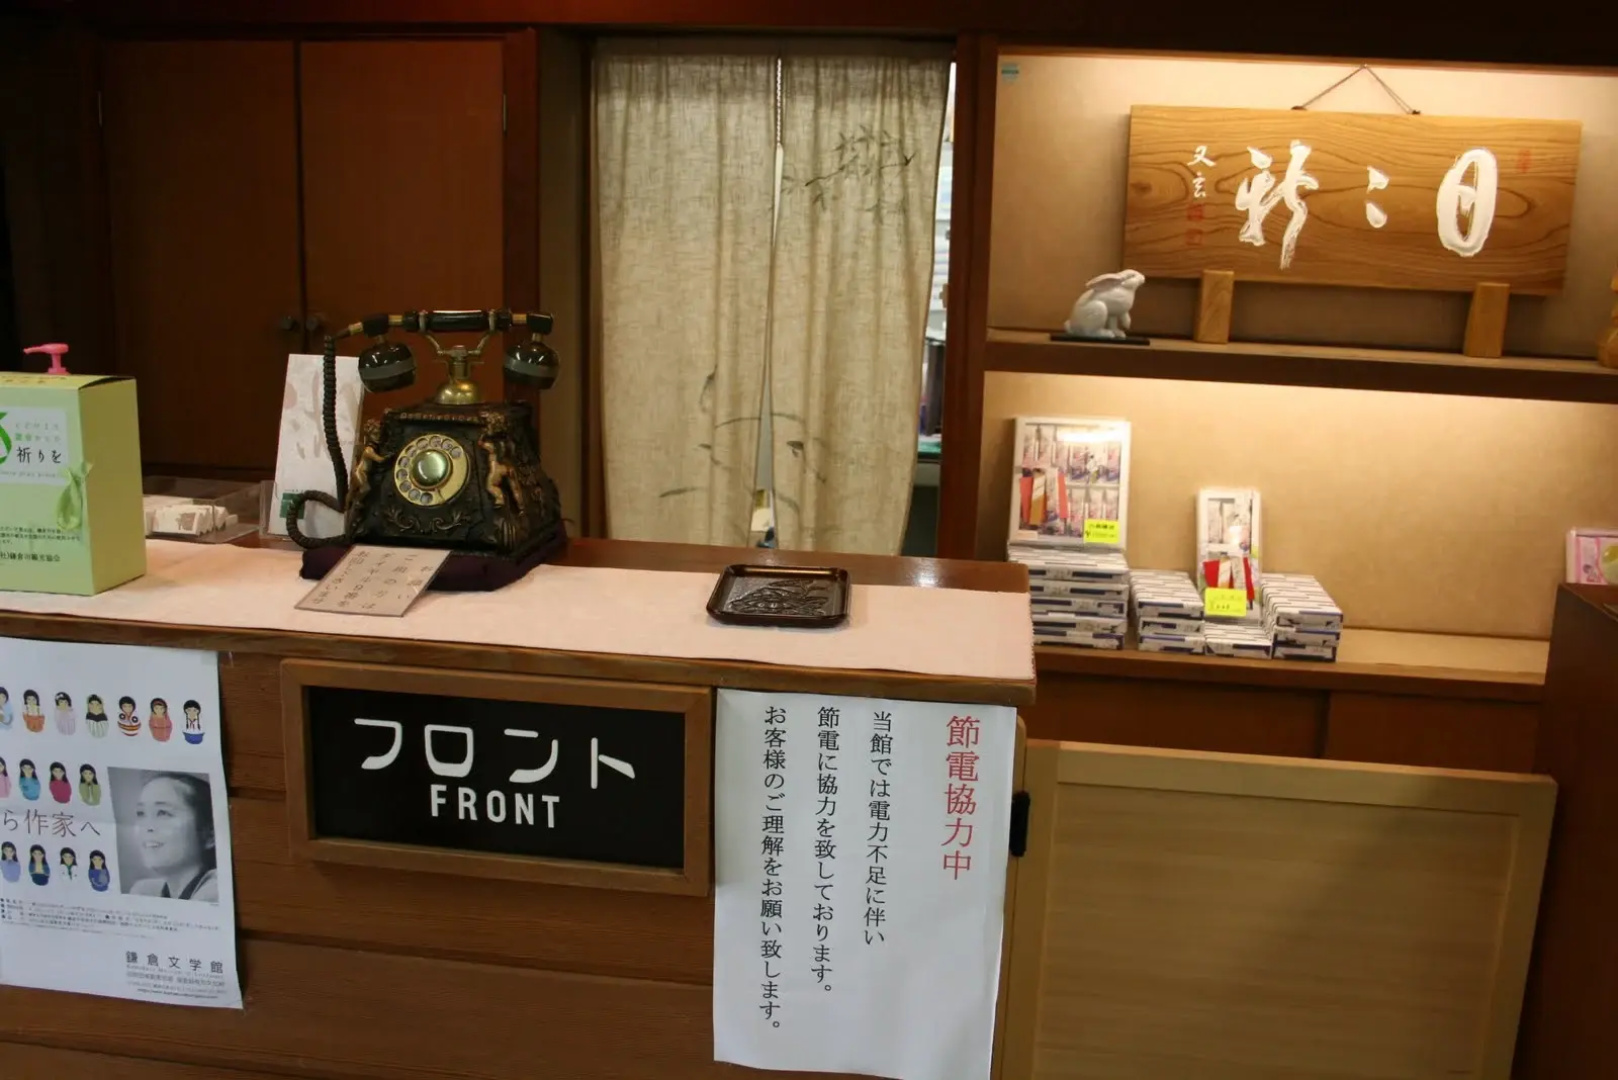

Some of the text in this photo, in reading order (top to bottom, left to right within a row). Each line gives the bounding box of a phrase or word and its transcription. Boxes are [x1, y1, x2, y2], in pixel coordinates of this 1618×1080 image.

[16, 446, 62, 464] 祈りを
[353, 717, 636, 790] フロント
[3, 808, 101, 838] ら作家へ
[429, 783, 561, 829] FRONT
[864, 710, 893, 944] 当館では電力不足に伴い
[941, 715, 981, 880] 節電協力中
[759, 706, 786, 1029] お客様のご理解をお願い致します。
[811, 706, 840, 992] 節電に協力を致しております。
[125, 950, 224, 974] 鎌倉文学館
